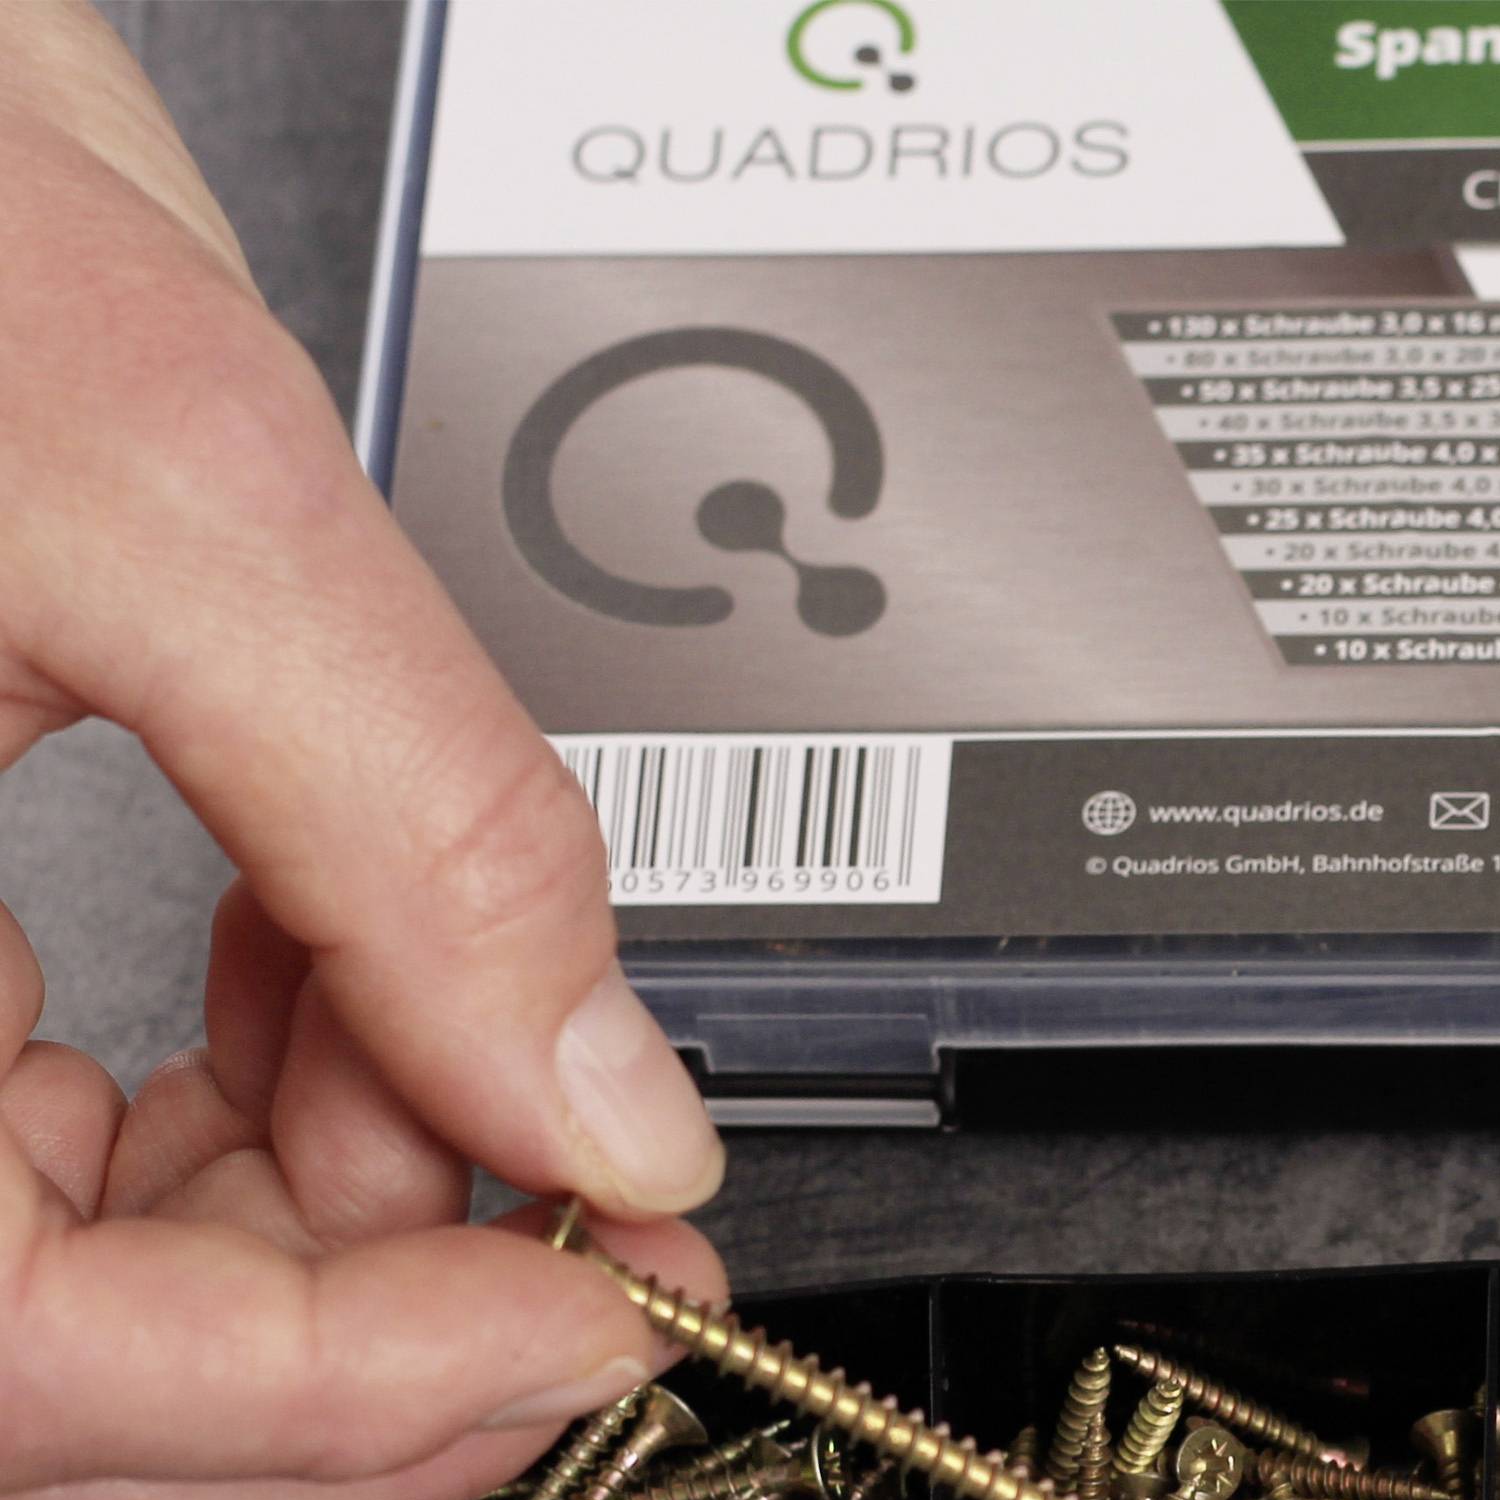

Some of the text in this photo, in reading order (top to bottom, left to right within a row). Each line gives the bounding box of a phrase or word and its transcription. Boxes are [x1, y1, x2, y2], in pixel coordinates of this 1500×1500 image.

[571, 120, 1131, 184] QUADRIOS
[1265, 508, 1299, 529] 25
[1304, 513, 1322, 528] x
[1328, 508, 1461, 527] Schraube
[1283, 542, 1315, 561] 20
[1323, 546, 1338, 559] x
[1346, 542, 1477, 559] Schraube
[1298, 574, 1334, 594] 20
[1338, 578, 1356, 593] x
[1362, 574, 1495, 593] Schraube
[1319, 607, 1349, 625] 10
[1357, 612, 1371, 625] x
[1334, 639, 1367, 659] 10
[1372, 643, 1390, 659] x
[1149, 801, 1384, 827] www.quadrios.de
[1112, 855, 1219, 878] Quadrios
[1225, 855, 1305, 876] GmbH,
[1312, 854, 1485, 874] Bahnhofstraße
